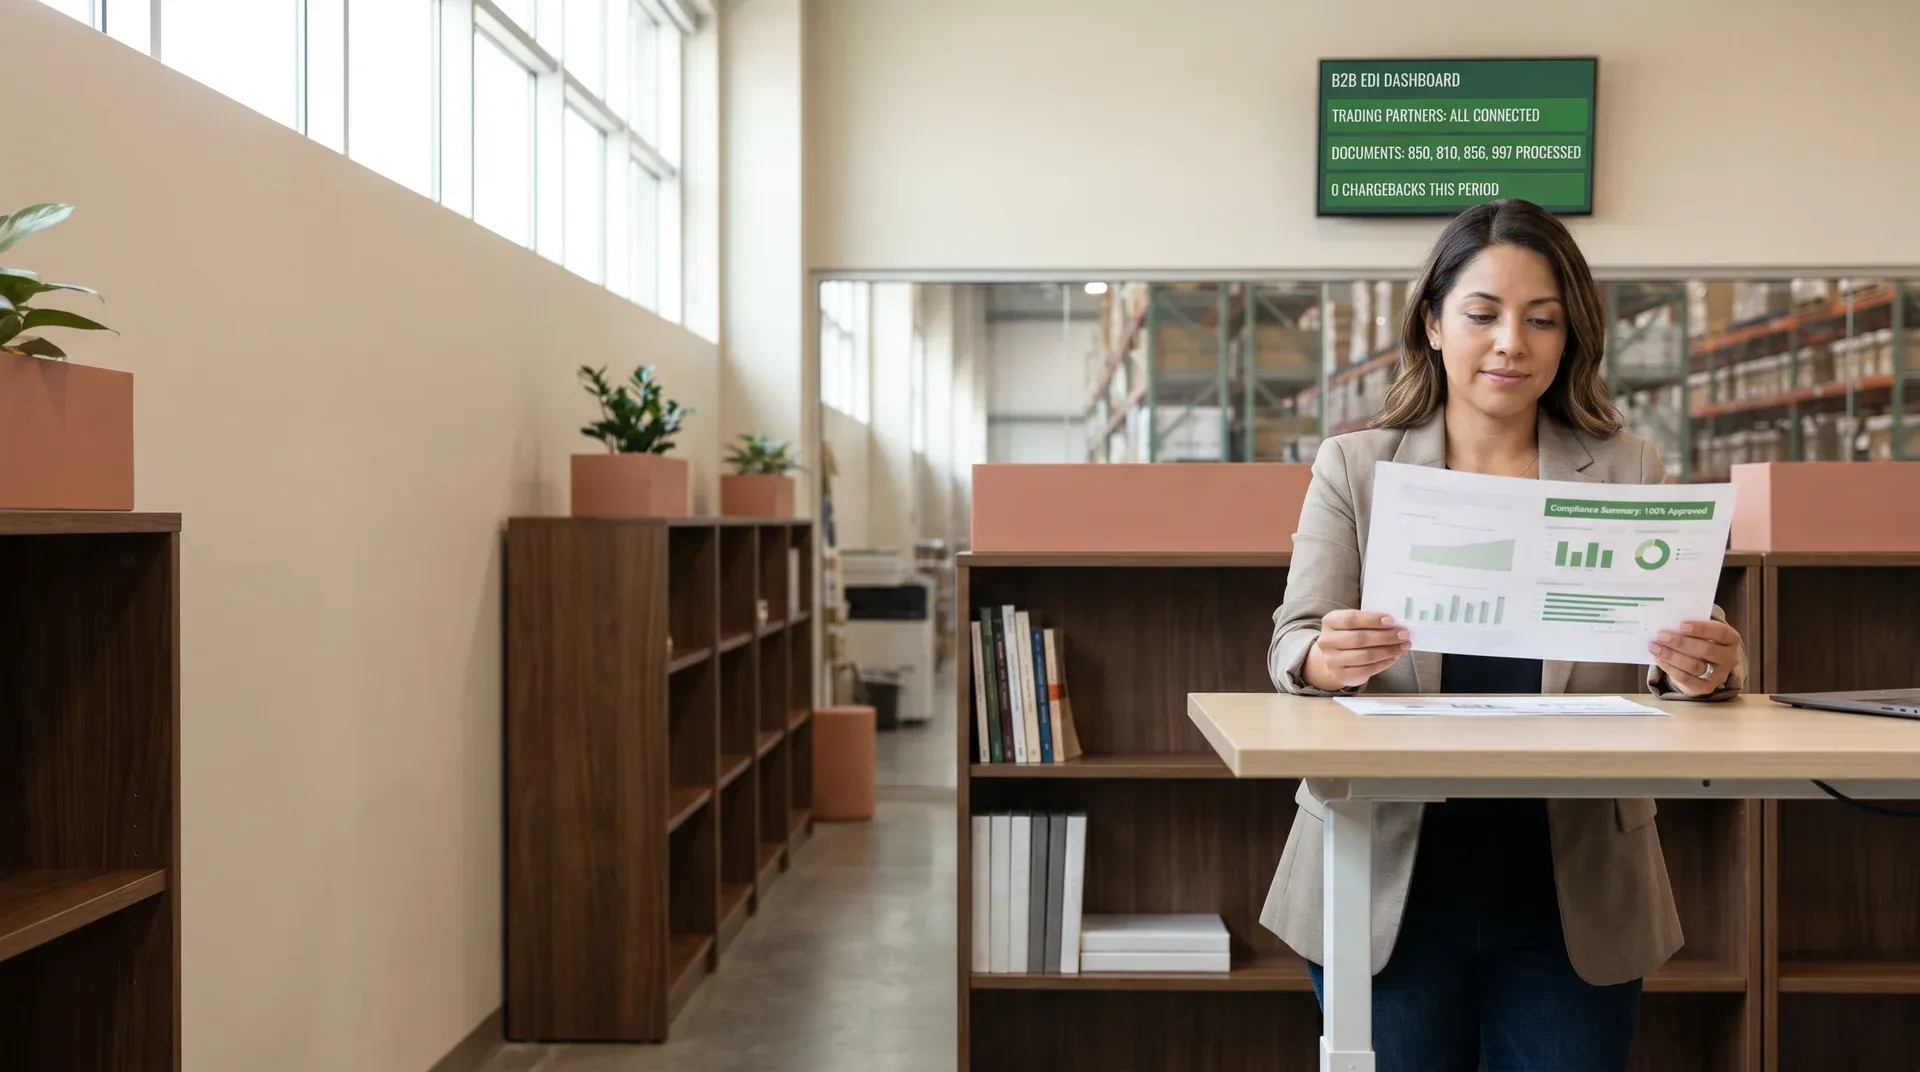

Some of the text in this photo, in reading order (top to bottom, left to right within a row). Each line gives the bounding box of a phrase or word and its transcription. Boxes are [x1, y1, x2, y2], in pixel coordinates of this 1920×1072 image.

[1331, 72, 1460, 87] B2B EDI DASHBOARD
[1332, 108, 1540, 122] TRADING PARTNERS: ALL CONNECTED
[1331, 145, 1581, 161] DOCUMENTS: 850, 810, 856, 997 PROCESSED
[1331, 182, 1499, 197] 0 CHARGEBACKS THIS PERIOD
[1550, 504, 1707, 517] Compliance Summary: 100% Approved
